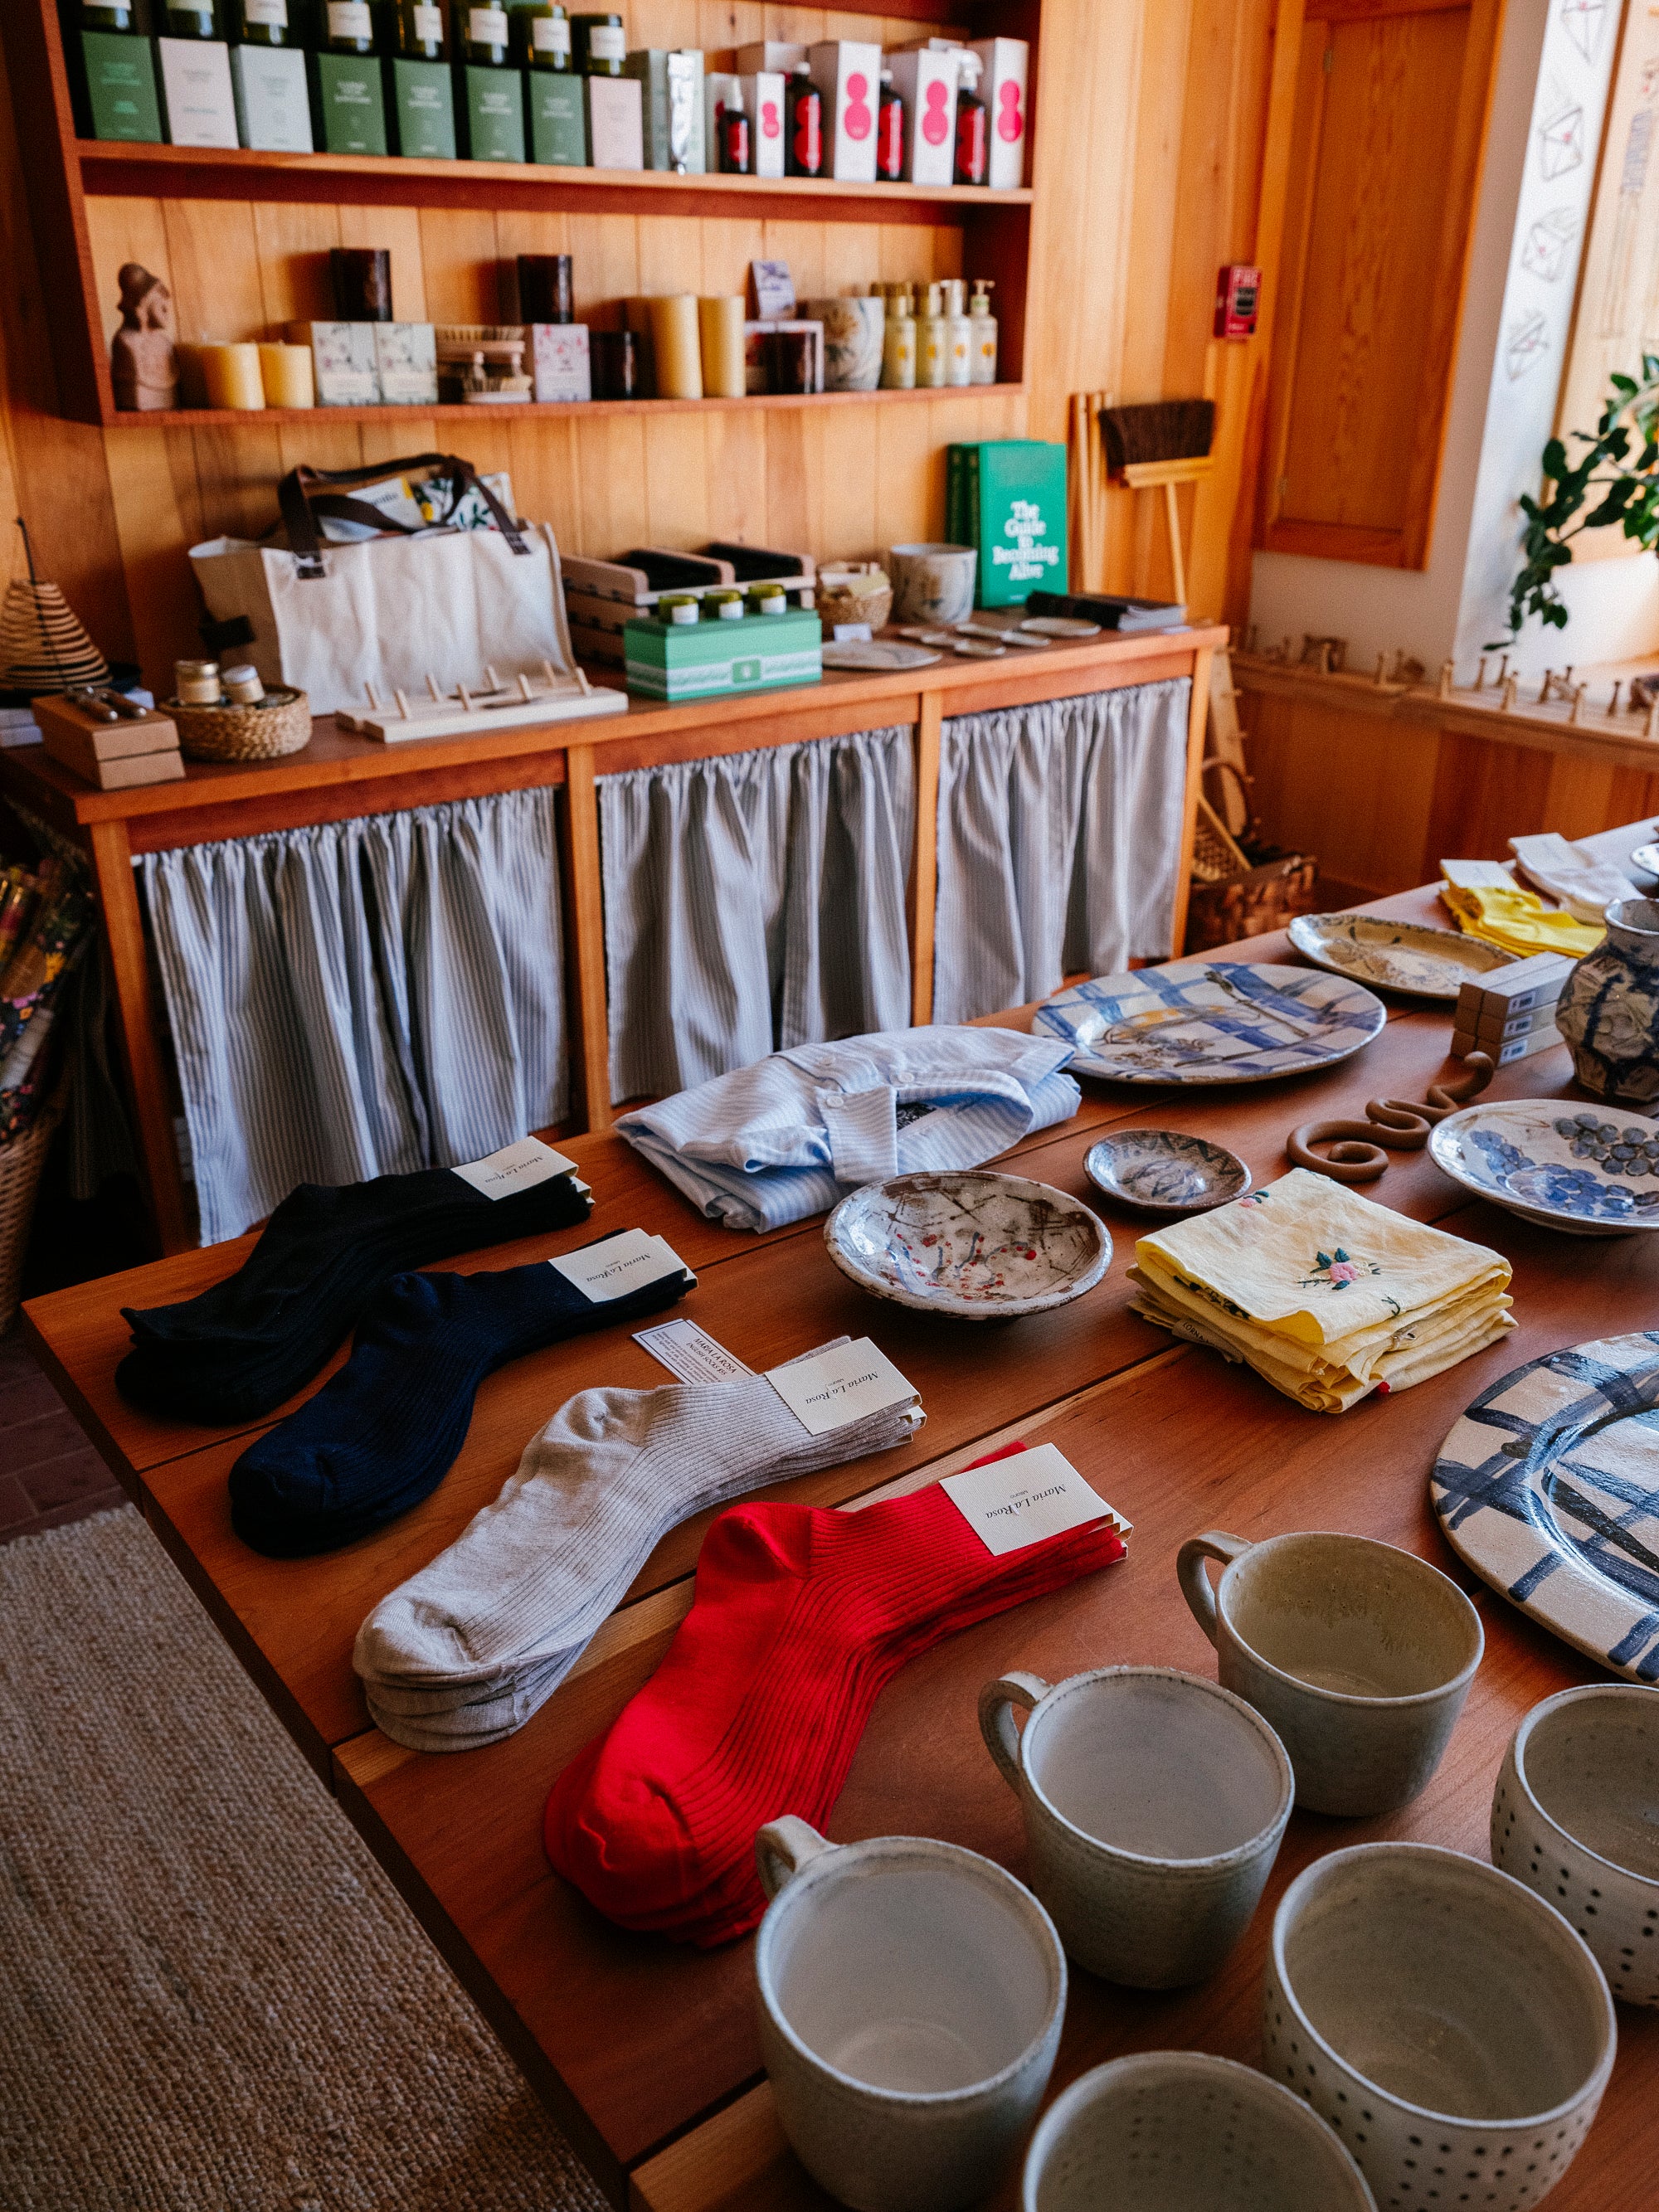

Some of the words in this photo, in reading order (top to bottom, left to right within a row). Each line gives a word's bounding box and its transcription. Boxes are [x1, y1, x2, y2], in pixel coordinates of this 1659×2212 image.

[518, 1156, 543, 1169] Maria
[623, 1253, 650, 1267] Maria
[586, 1271, 609, 1281] Rosa
[686, 1343, 706, 1357] ENGLISH
[703, 1356, 719, 1369] SOCKS
[693, 1339, 713, 1354] MARIA
[719, 1359, 737, 1373] ROSA
[848, 1371, 878, 1388] Maria
[832, 1385, 846, 1394] La
[805, 1393, 830, 1404] Rosa
[1010, 1490, 1029, 1499] Milano
[1031, 1484, 1067, 1501] Maria
[1014, 1498, 1030, 1509] La
[985, 1505, 1013, 1519] Rosa
